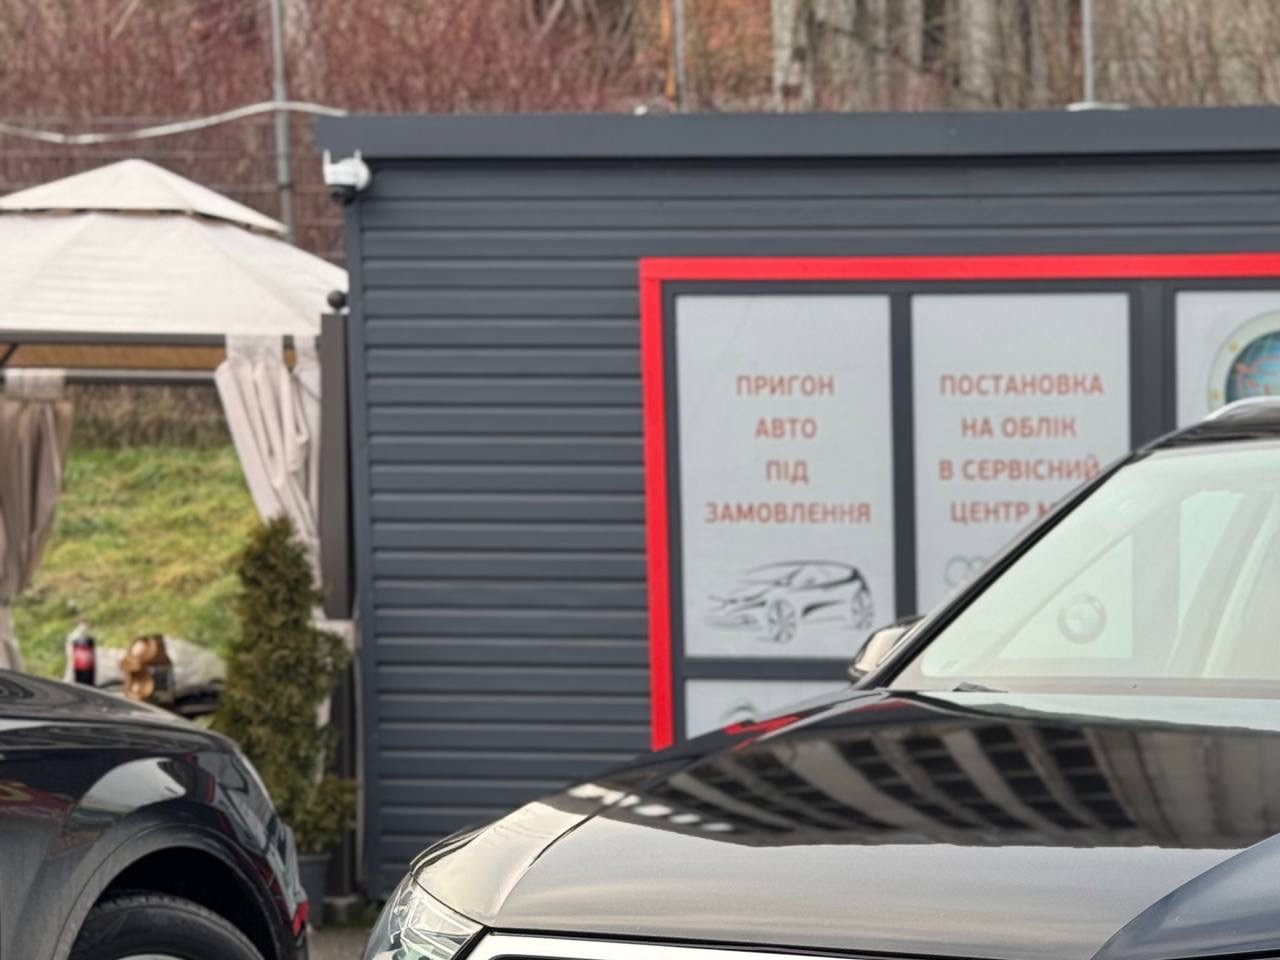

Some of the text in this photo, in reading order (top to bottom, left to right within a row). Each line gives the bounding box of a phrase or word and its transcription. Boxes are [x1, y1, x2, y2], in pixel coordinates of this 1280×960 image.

[736, 374, 834, 396] ПРИГОН
[939, 374, 1104, 396] ПОСТАНОВКА
[755, 417, 817, 439] АВТО
[960, 416, 1077, 438] НА ОБЛІК
[765, 460, 809, 485] ПІД
[938, 454, 1102, 481] В СЕРВІСНИЙ
[705, 501, 872, 524] ЗАМОВЛЕННЯ
[951, 501, 1029, 526] ЦЕНТР
